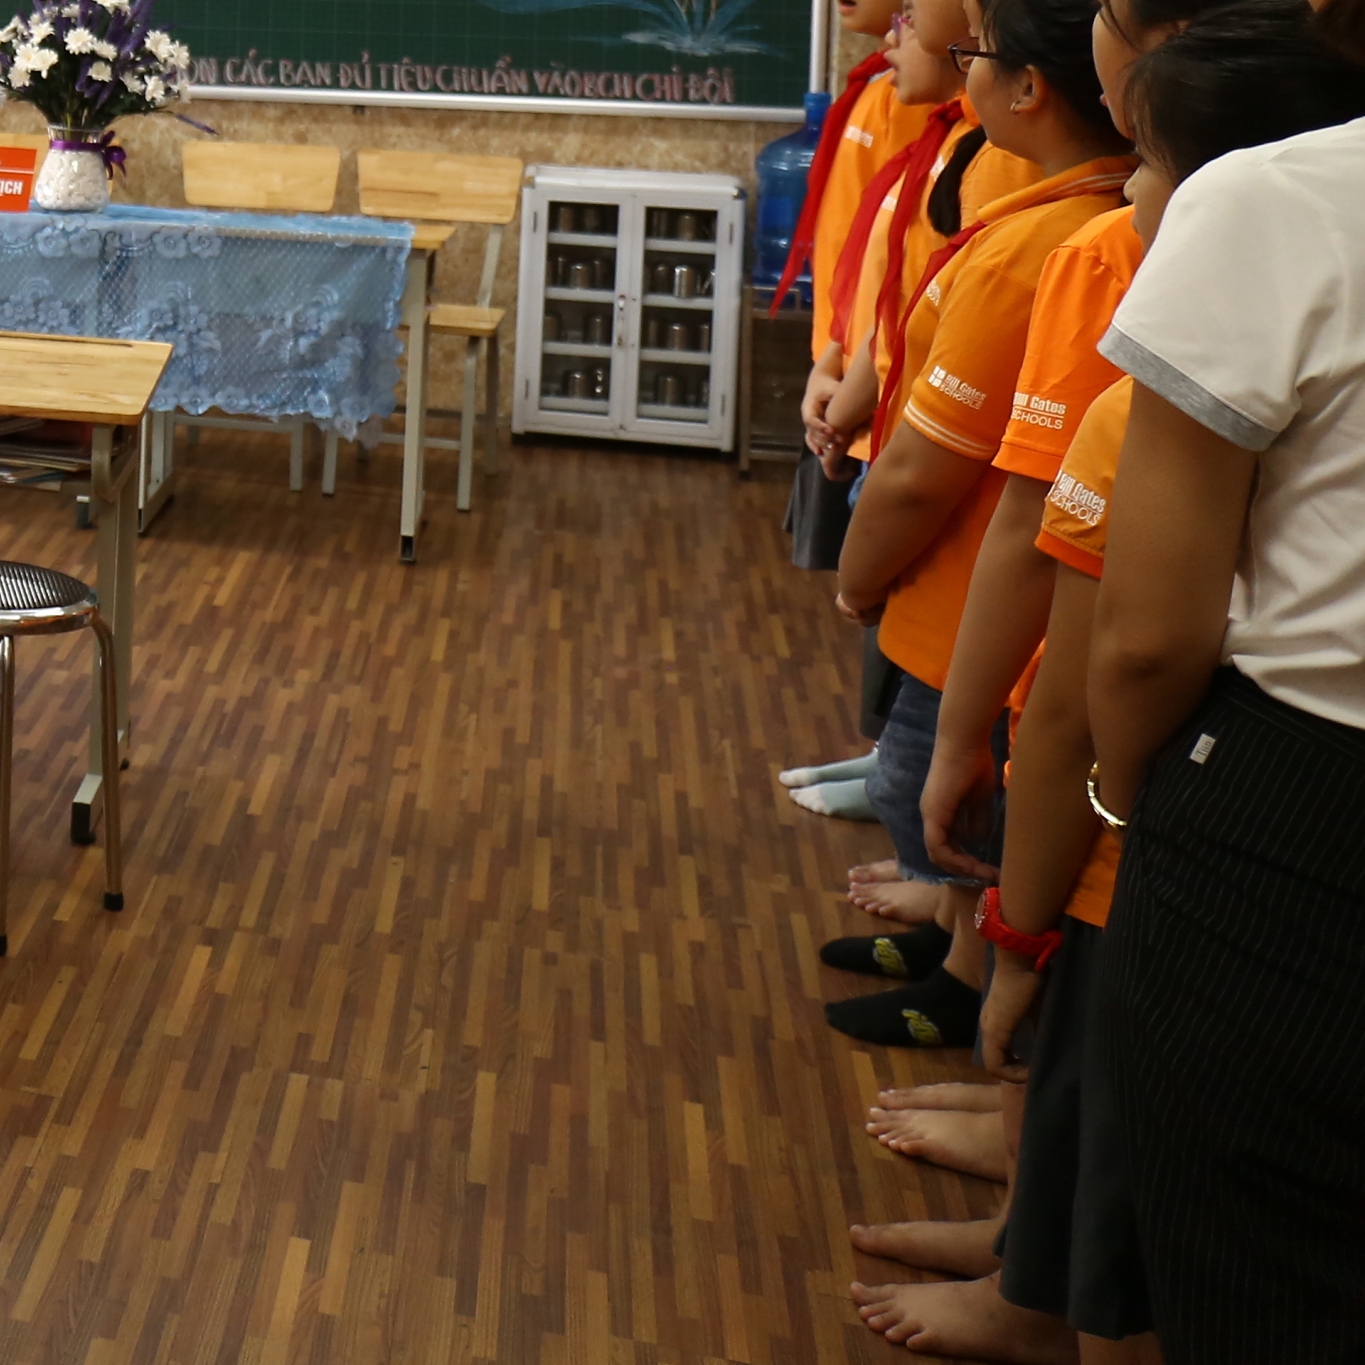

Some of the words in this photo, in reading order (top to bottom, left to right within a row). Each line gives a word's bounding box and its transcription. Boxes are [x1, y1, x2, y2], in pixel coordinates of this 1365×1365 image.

[225, 48, 273, 85] CÁC
[939, 384, 983, 410] SCHOOLS
[959, 382, 986, 401] Gates
[1030, 396, 1066, 415] Gates
[1050, 490, 1100, 526] SCHOOLS
[1072, 483, 1106, 513] Gates
